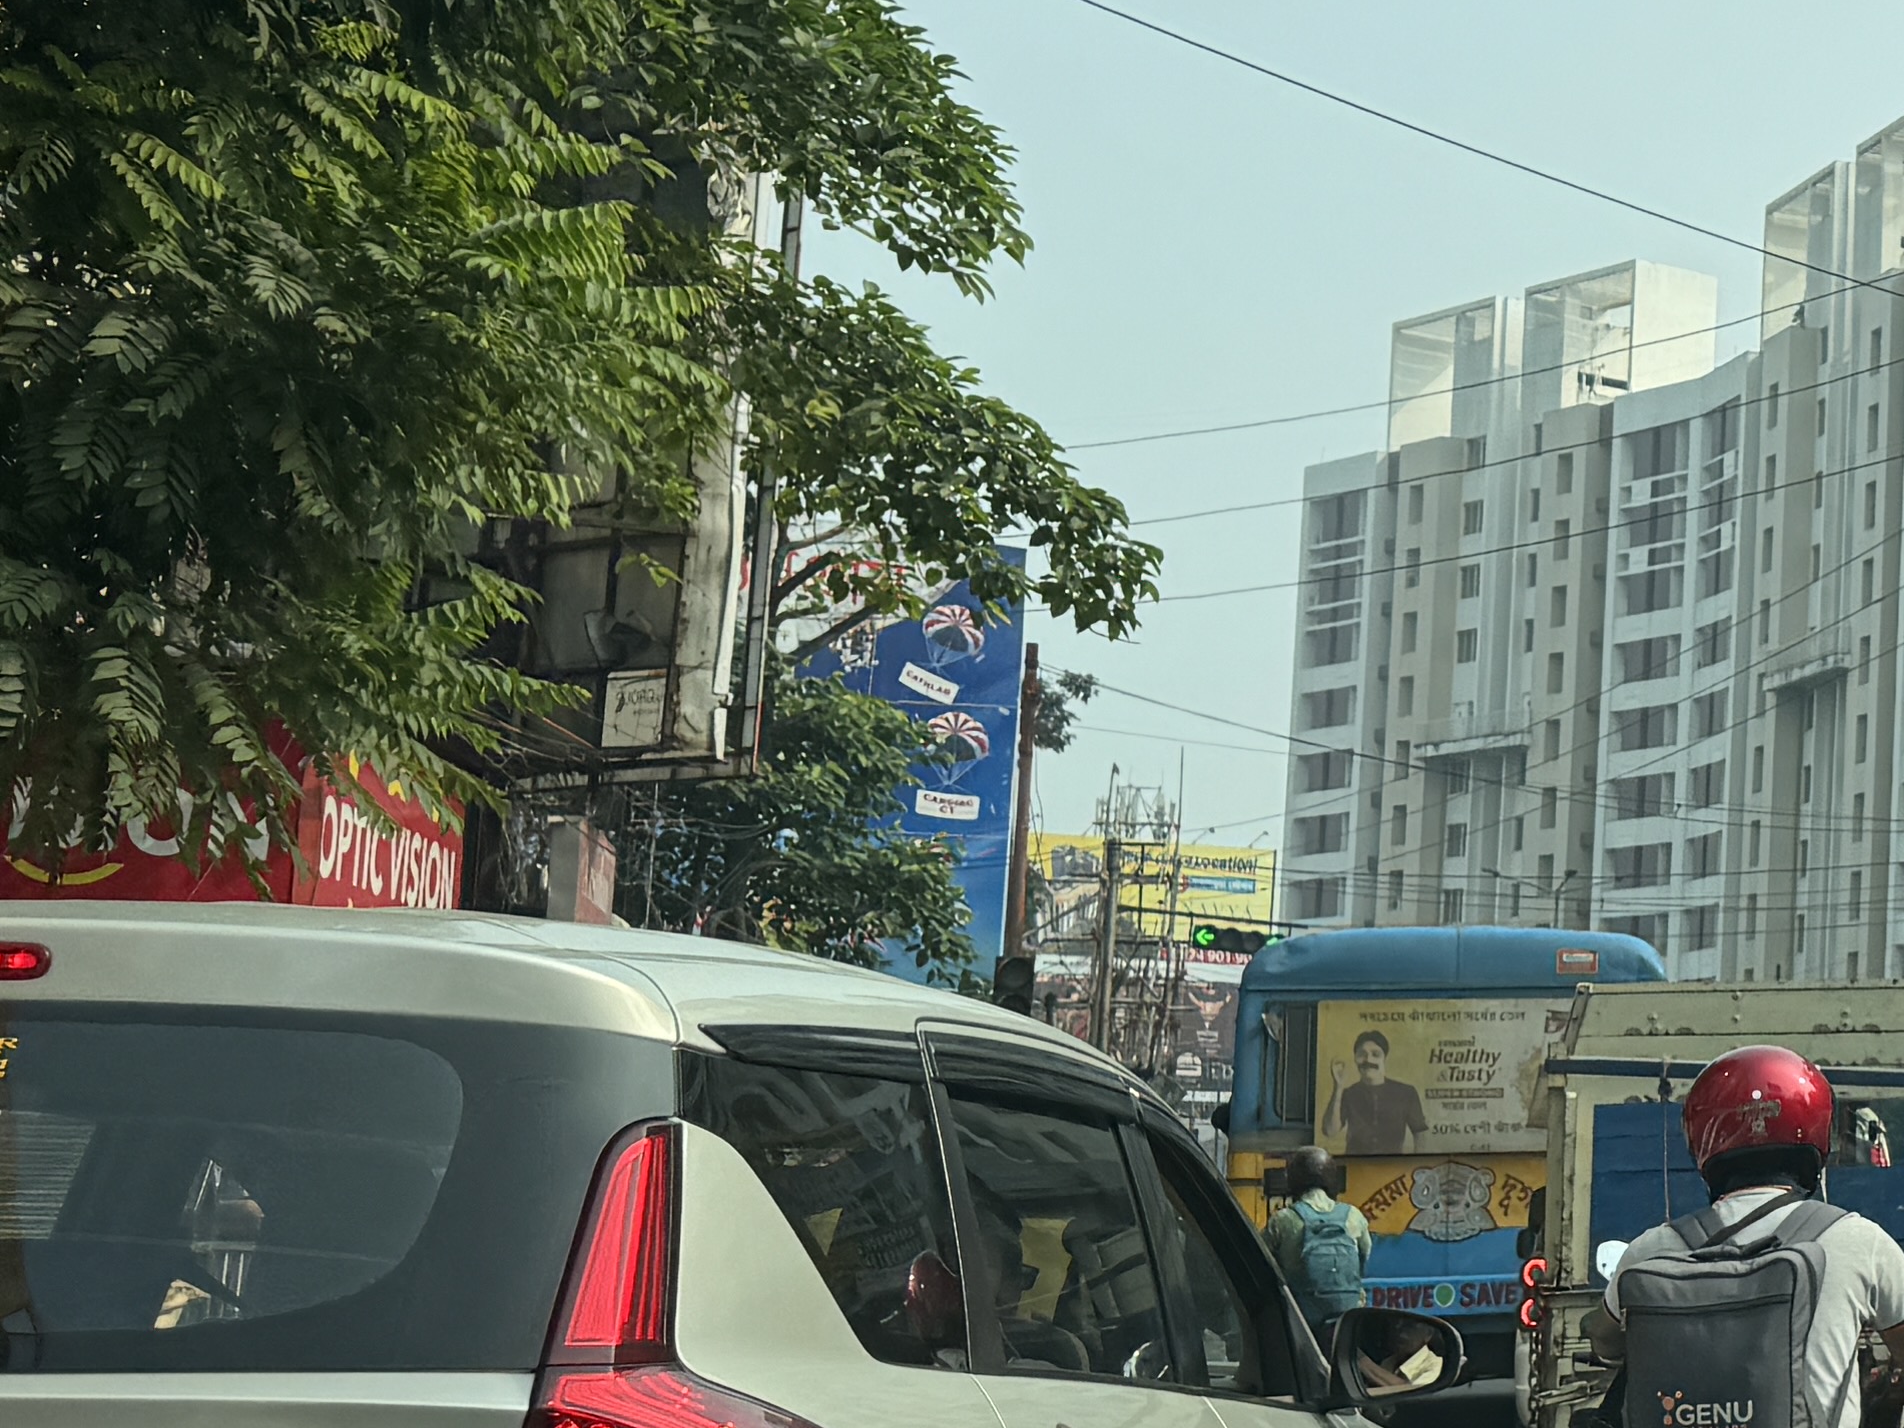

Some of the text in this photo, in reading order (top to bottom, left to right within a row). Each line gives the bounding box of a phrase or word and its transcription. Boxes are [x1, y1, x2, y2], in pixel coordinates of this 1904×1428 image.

[319, 795, 384, 897] OPTIC
[390, 826, 457, 909] VISION
[1428, 1048, 1502, 1068] Healthy
[1372, 1283, 1518, 1309] DRIVE SAVE
[1675, 1399, 1754, 1426] GENU
